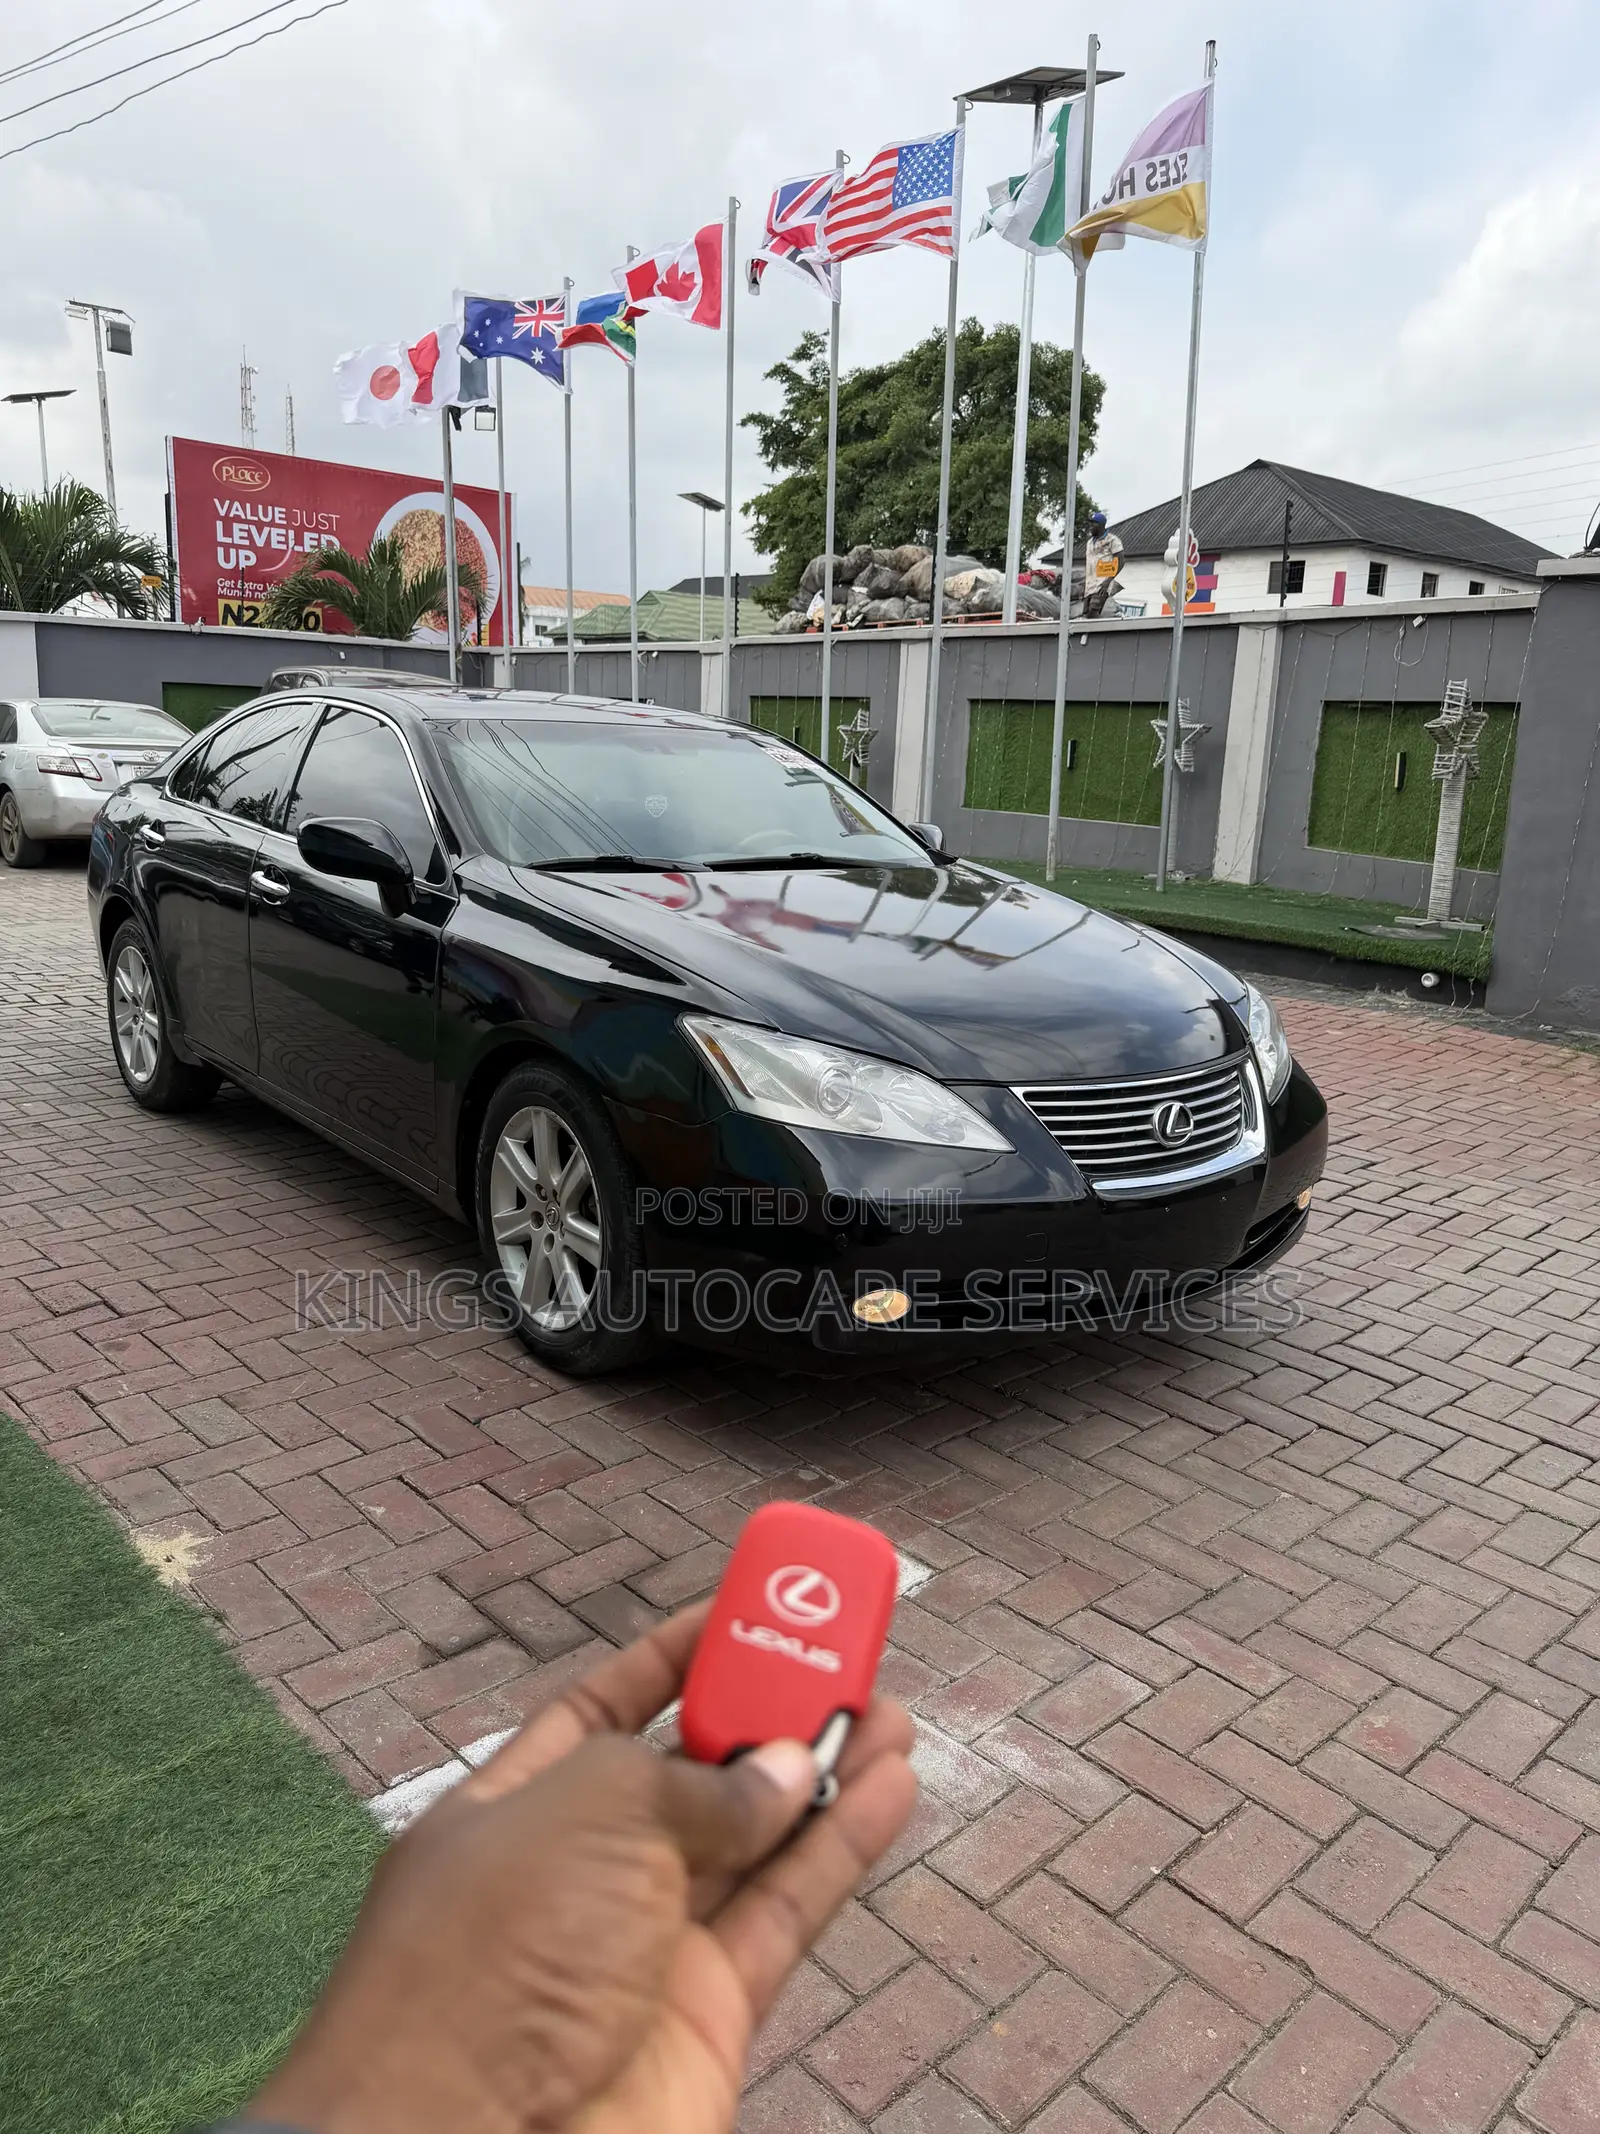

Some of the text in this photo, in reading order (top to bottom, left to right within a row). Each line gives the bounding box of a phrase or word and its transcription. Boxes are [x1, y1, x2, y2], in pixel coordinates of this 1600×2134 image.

[213, 498, 340, 531] VALUE JUST
[216, 520, 341, 553] LEVELED
[217, 546, 257, 570] UP
[217, 578, 235, 588] Get
[237, 580, 264, 591] Extra
